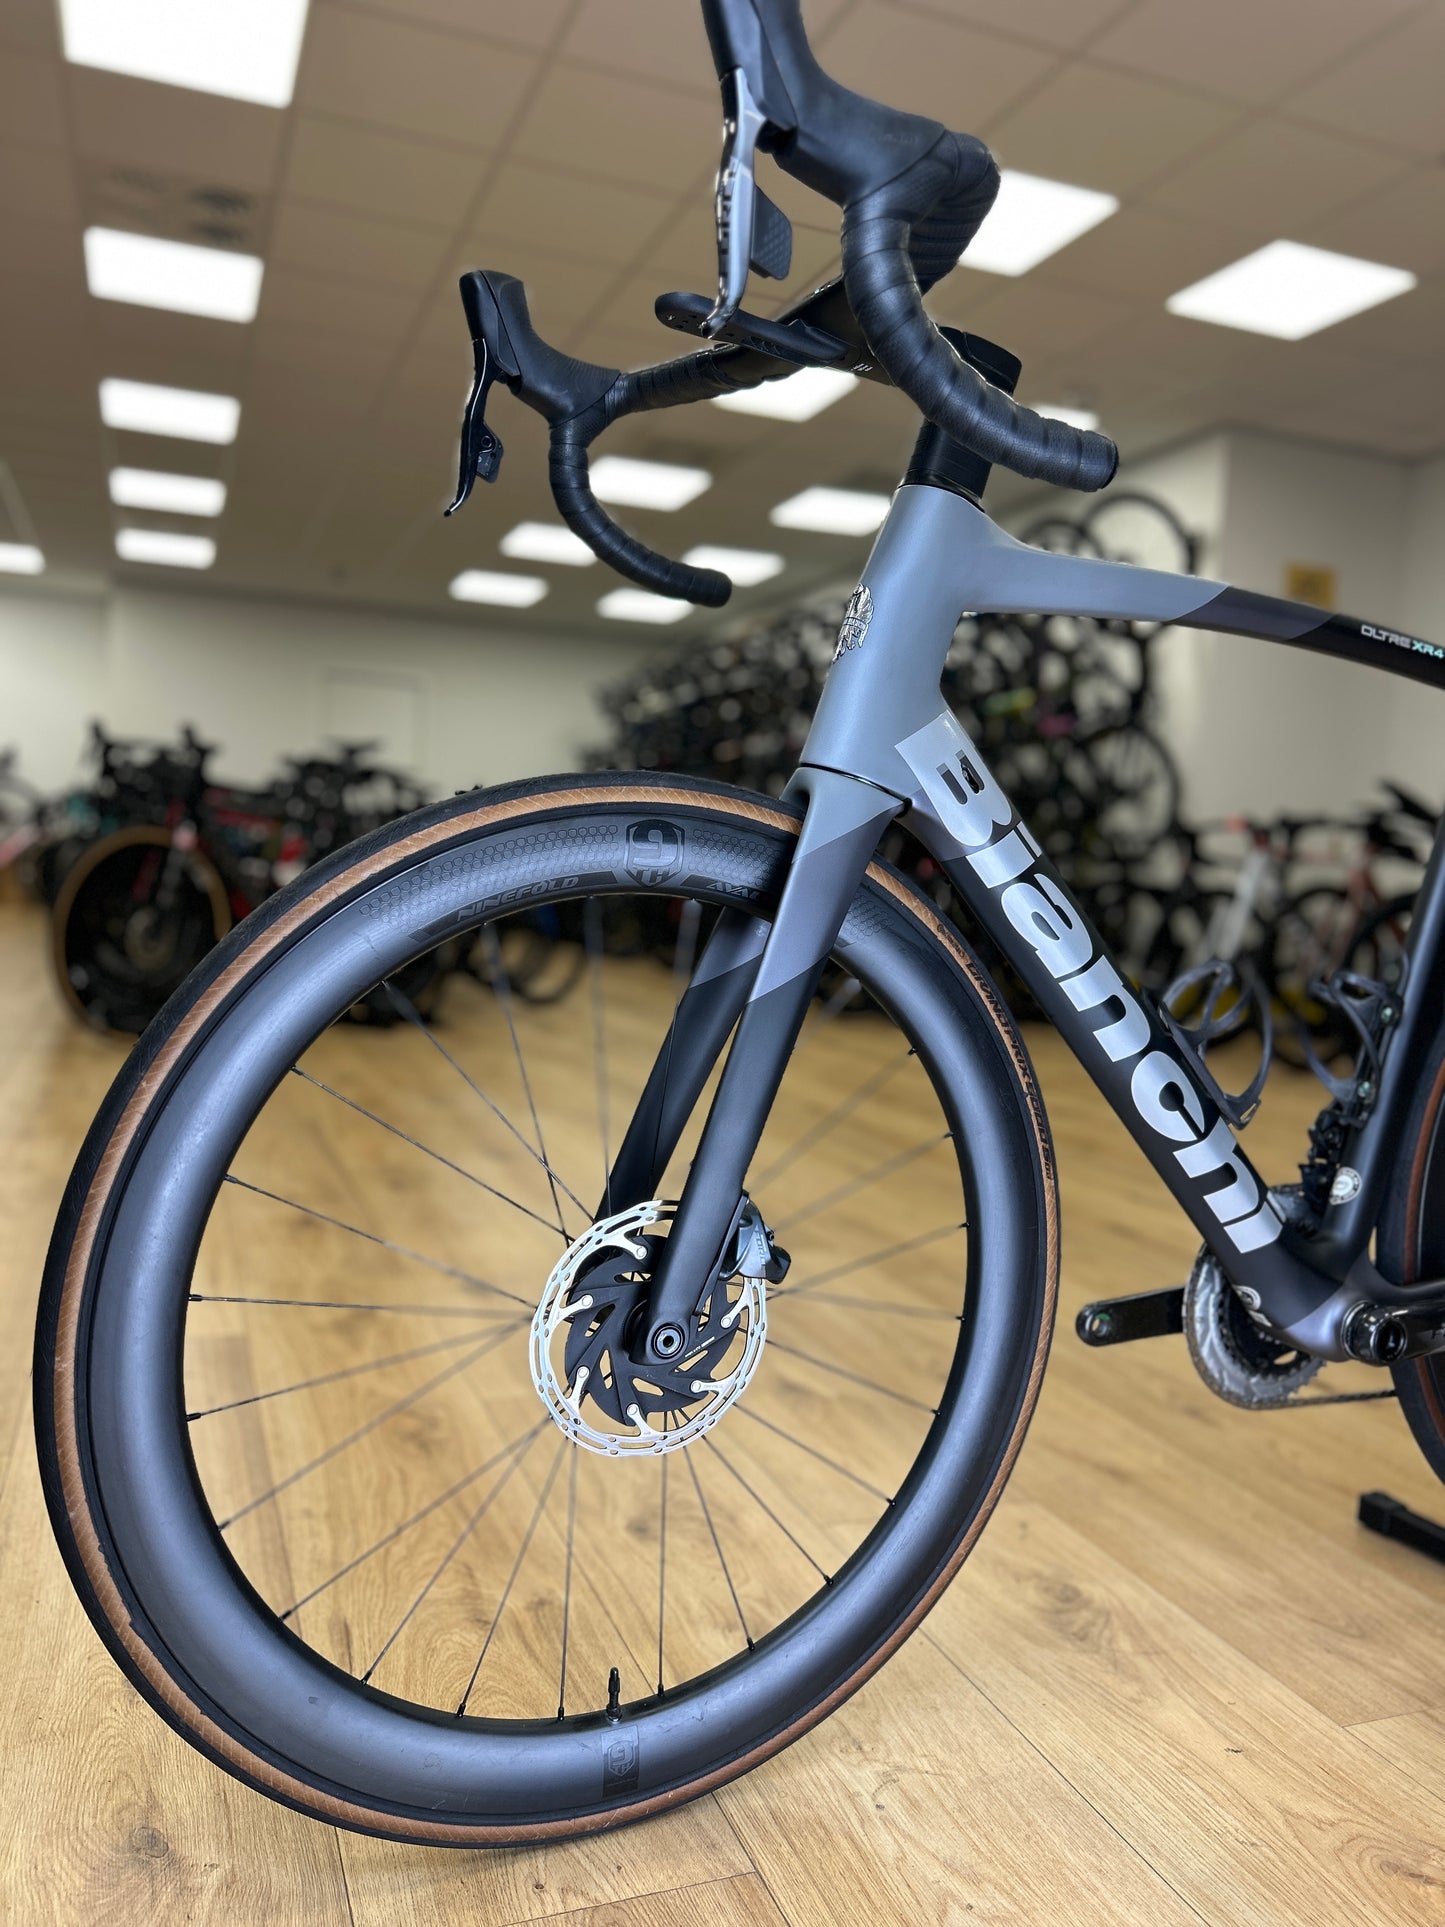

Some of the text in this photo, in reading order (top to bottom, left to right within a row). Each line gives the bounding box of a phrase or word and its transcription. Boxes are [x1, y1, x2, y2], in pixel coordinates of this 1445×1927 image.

[1361, 624, 1444, 658] OLTRE XR4
[457, 876, 579, 922] NINEFOLD
[895, 710, 1286, 1254] Bianchi
[966, 963, 1010, 1028] GRAND
[1004, 1029, 1032, 1080] PRIX
